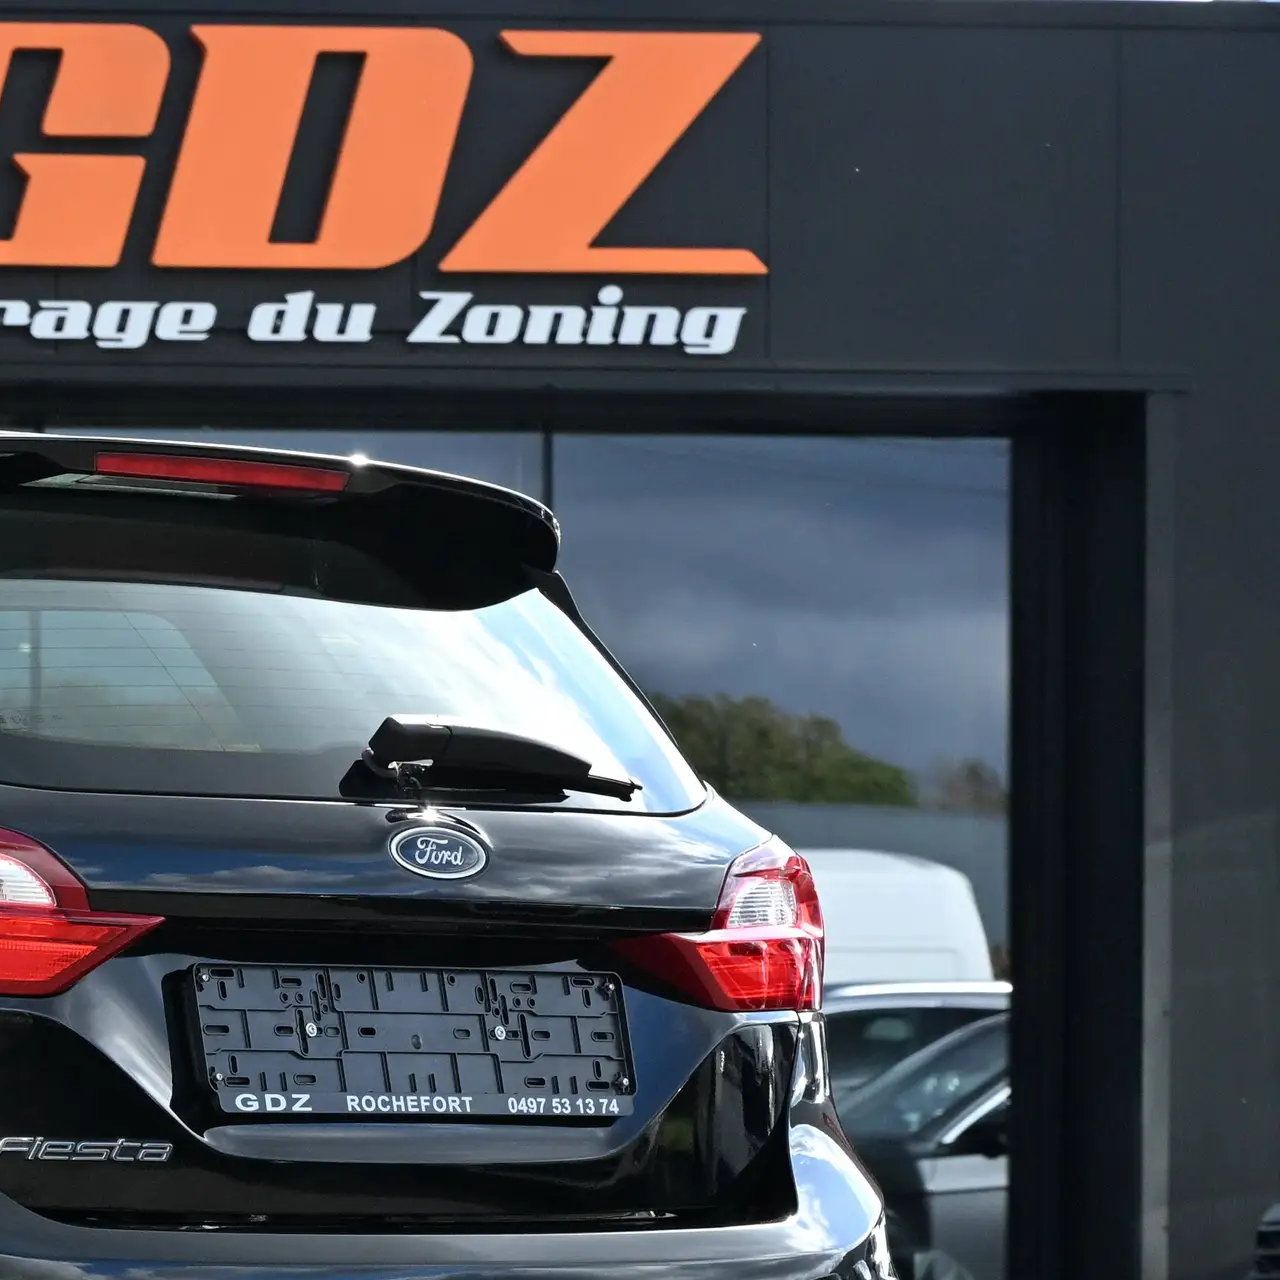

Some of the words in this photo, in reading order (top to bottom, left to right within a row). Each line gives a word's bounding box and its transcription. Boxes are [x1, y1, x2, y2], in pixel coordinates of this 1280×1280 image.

[246, 289, 377, 344] du
[405, 284, 747, 355] Zoning
[414, 836, 465, 866] Ford
[234, 1093, 314, 1112] GDZ
[346, 1095, 474, 1113] ROCHEFORT
[508, 1096, 547, 1114] 0497
[551, 1097, 572, 1114] 53
[576, 1098, 596, 1115] 13
[599, 1098, 620, 1115] 74
